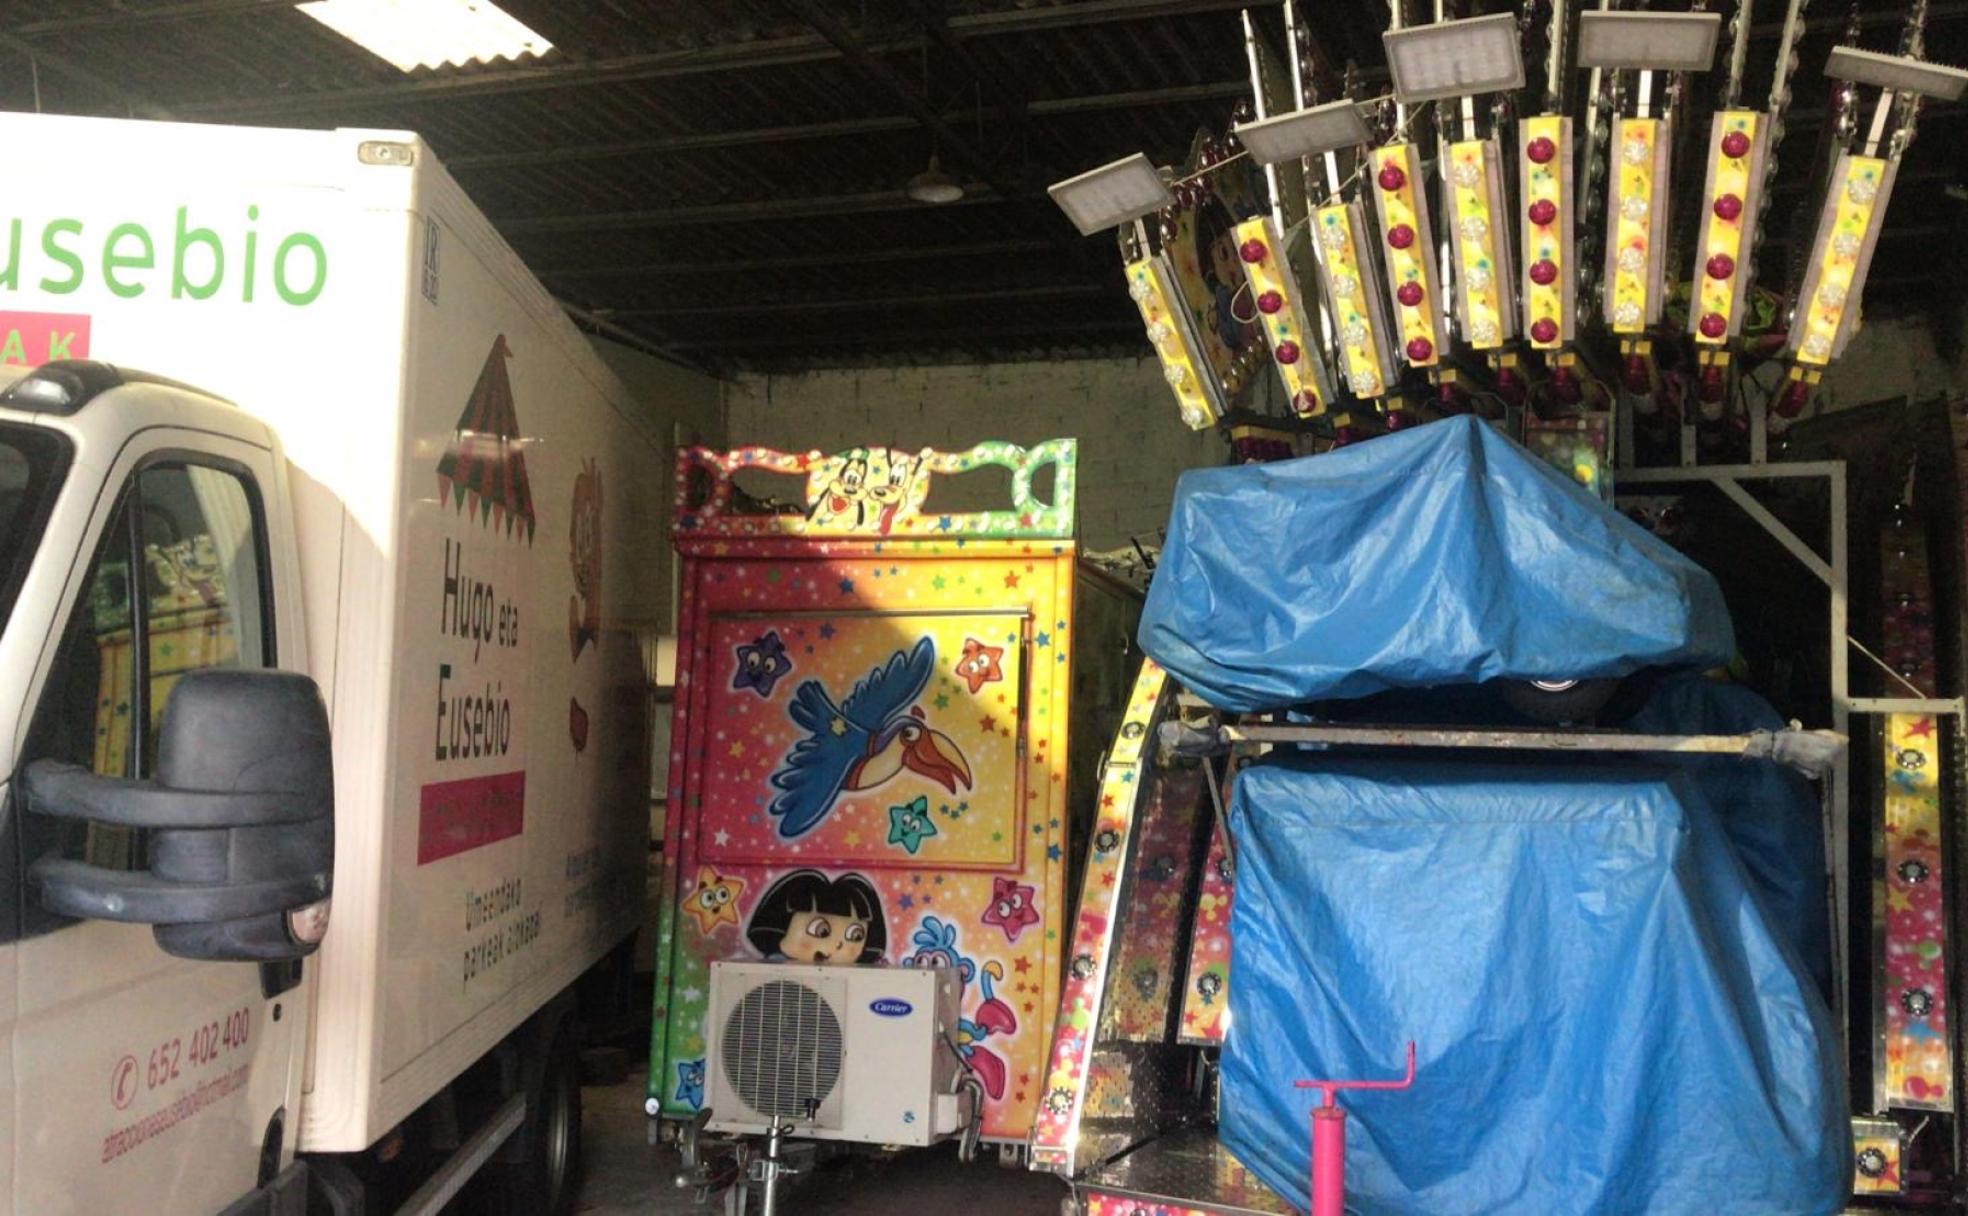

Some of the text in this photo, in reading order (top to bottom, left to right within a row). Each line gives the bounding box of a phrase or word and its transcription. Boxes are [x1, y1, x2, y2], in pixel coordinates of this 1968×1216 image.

[441, 537, 519, 664] Hugo eta
[434, 663, 511, 760] Eusebio
[148, 1006, 249, 1090] 652 402 400
[874, 1001, 909, 1014] Carrier
